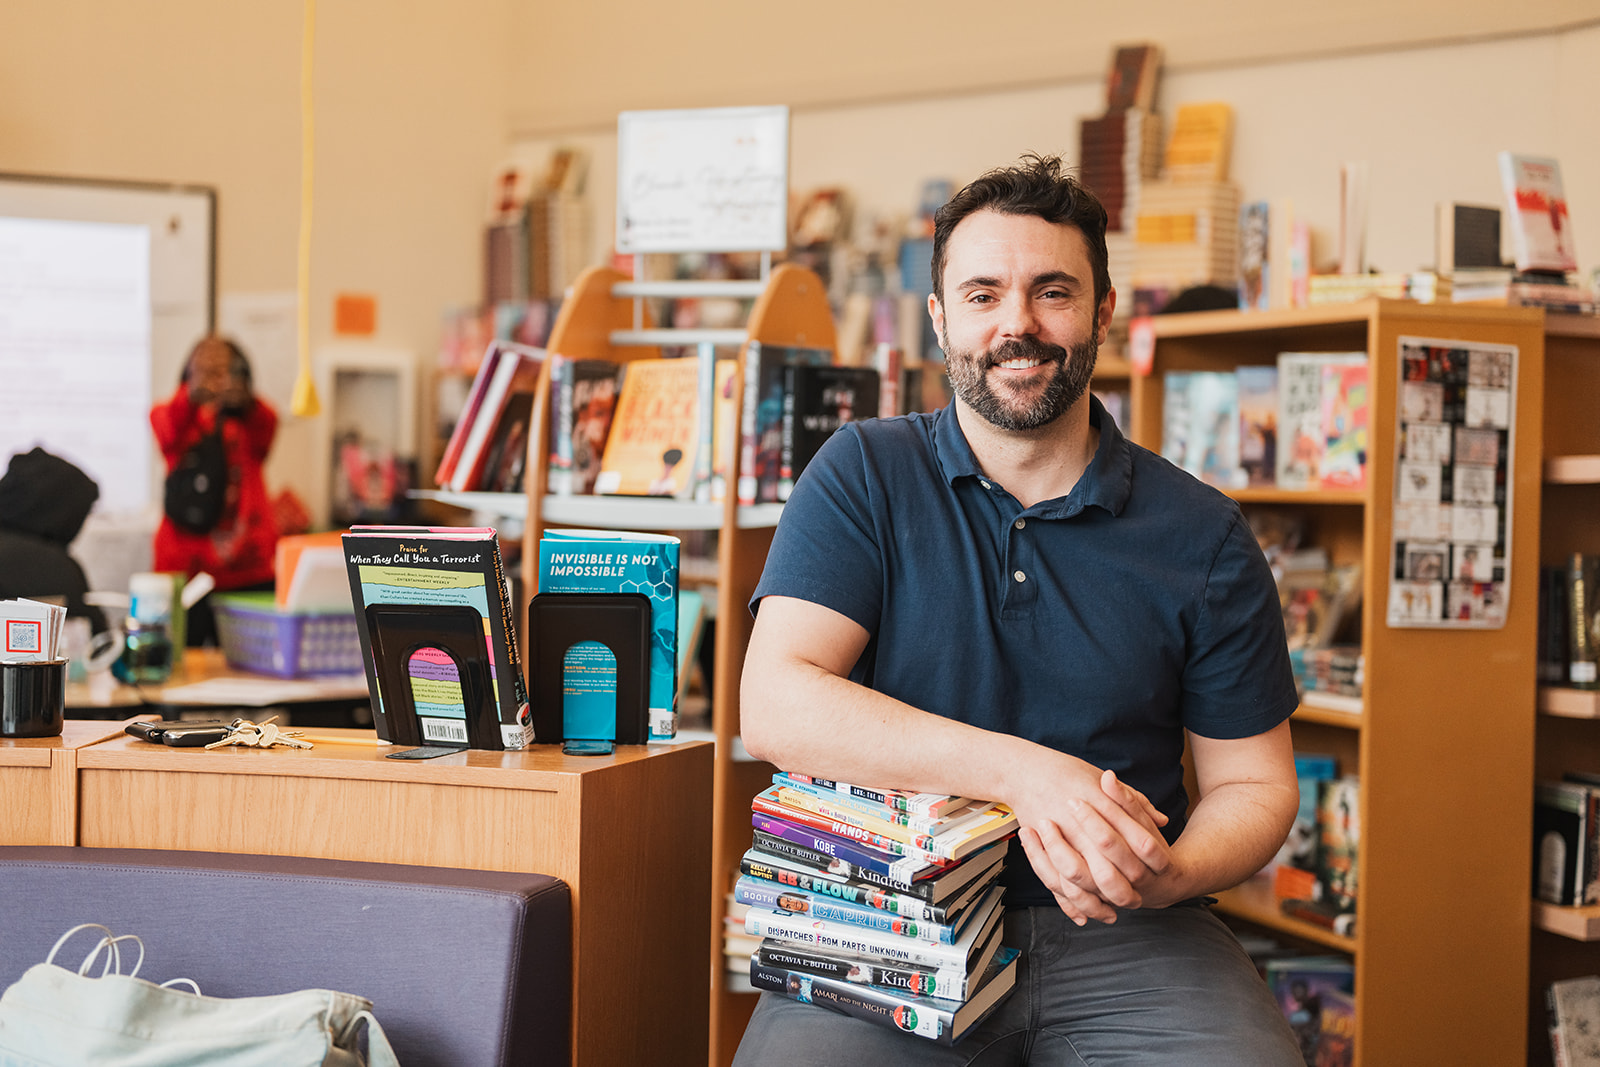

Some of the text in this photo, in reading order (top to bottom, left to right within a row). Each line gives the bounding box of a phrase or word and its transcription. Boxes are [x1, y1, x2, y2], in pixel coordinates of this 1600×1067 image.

[400, 544, 428, 554] Praise for
[350, 554, 371, 564] When
[372, 554, 392, 564] They
[394, 554, 410, 564] Call
[412, 553, 430, 563] You
[440, 554, 481, 564] Terrorist
[550, 553, 658, 566] INVISIBLE IS NOT
[550, 566, 626, 577] IMPOSSIBLE
[832, 822, 869, 841] HANDS
[761, 840, 789, 853] OCTAVIA
[796, 849, 821, 862] BUTLER
[814, 838, 836, 856] KOBE
[750, 863, 766, 872] KELLY
[750, 869, 773, 880] BAPTIST
[778, 870, 860, 902] EB & FLOW
[743, 891, 774, 904] BOOTH
[816, 902, 889, 930] CAPRIC
[768, 926, 909, 960] DISPATCHES FROM PARTS UNKNOWN
[769, 953, 802, 965] OCTAVIA
[809, 960, 838, 971] BUTLER
[758, 973, 782, 984] ALSTON
[813, 988, 838, 1003] AMARI
[862, 1002, 888, 1015] NIGHT
